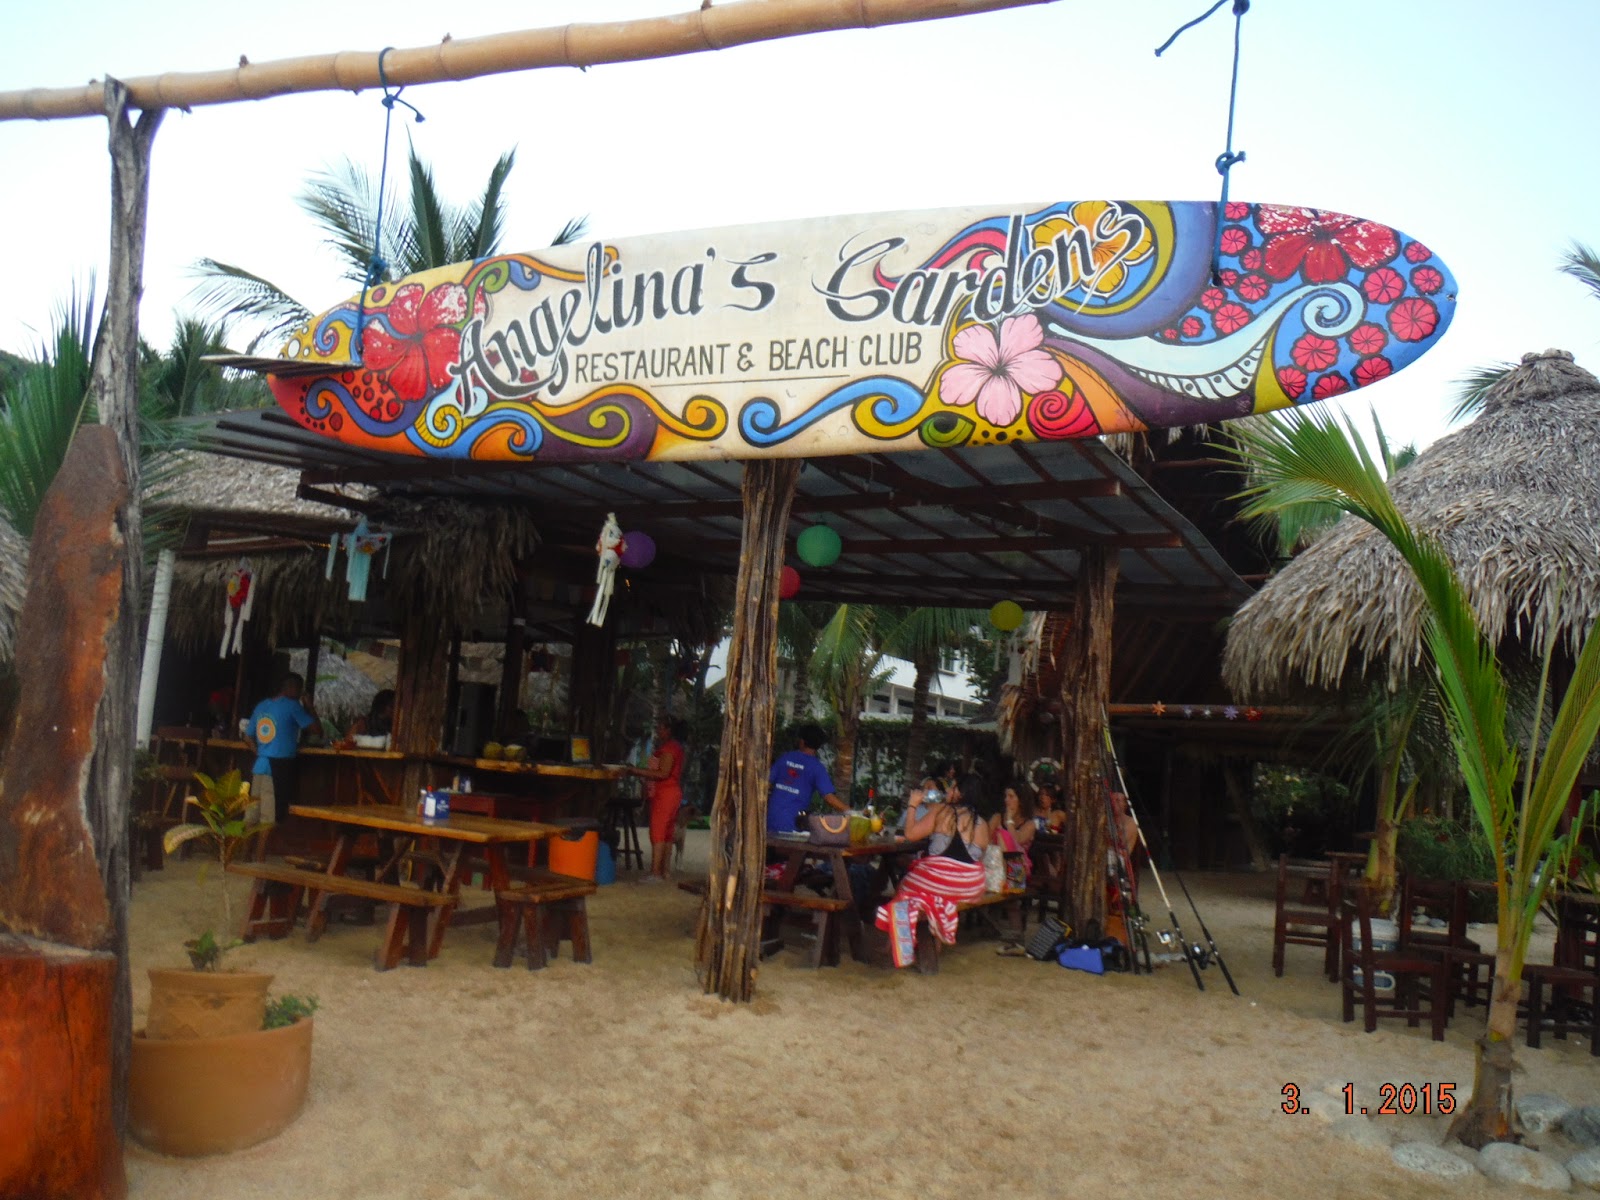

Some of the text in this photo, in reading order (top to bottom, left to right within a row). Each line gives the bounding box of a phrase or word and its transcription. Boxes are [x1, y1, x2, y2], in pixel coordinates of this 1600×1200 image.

[449, 241, 778, 415] Angelina's
[575, 331, 922, 383] RESTAURANT & BEACH CLUB
